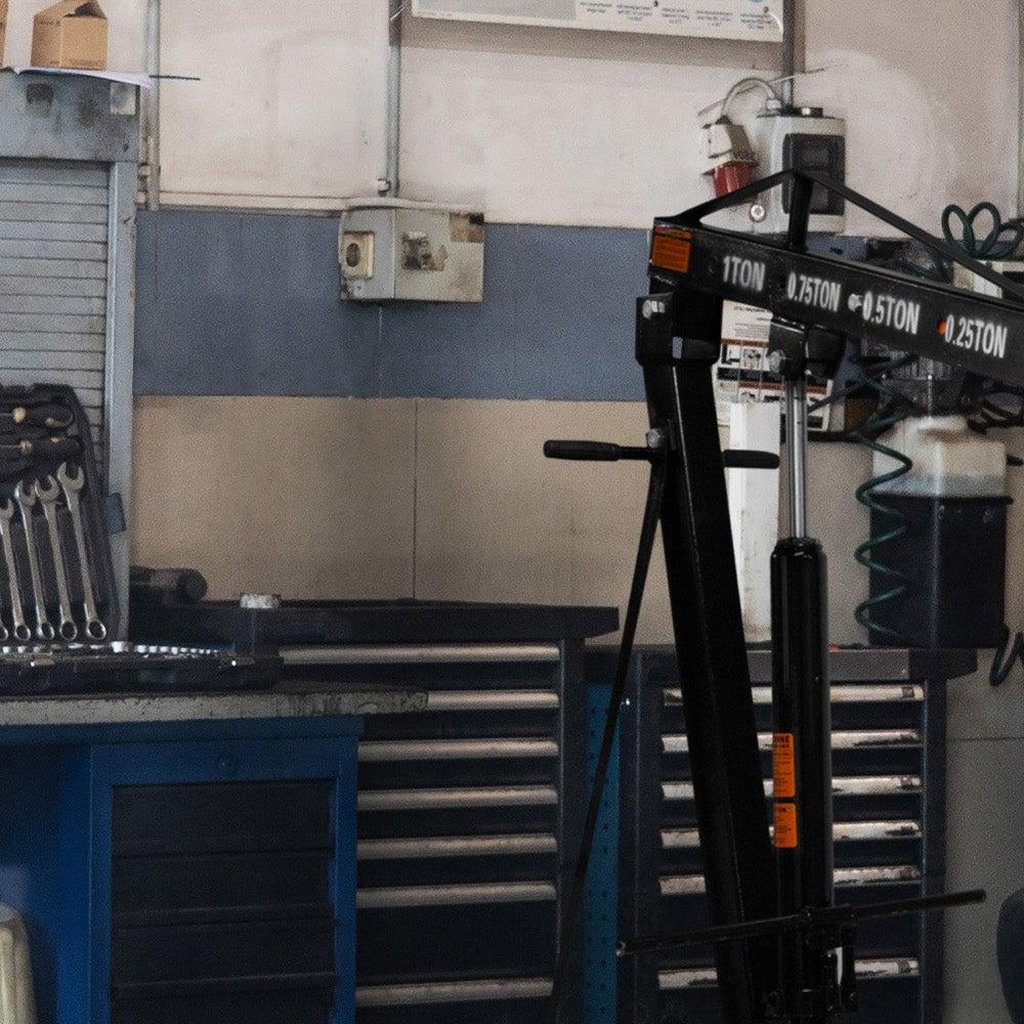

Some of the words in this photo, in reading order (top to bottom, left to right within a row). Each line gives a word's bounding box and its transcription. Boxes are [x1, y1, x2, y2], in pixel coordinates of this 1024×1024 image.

[723, 256, 766, 292] 1TON
[787, 271, 841, 312] 0.75TON
[862, 291, 921, 335] 0.5TON
[945, 314, 1008, 359] 0.25TON
